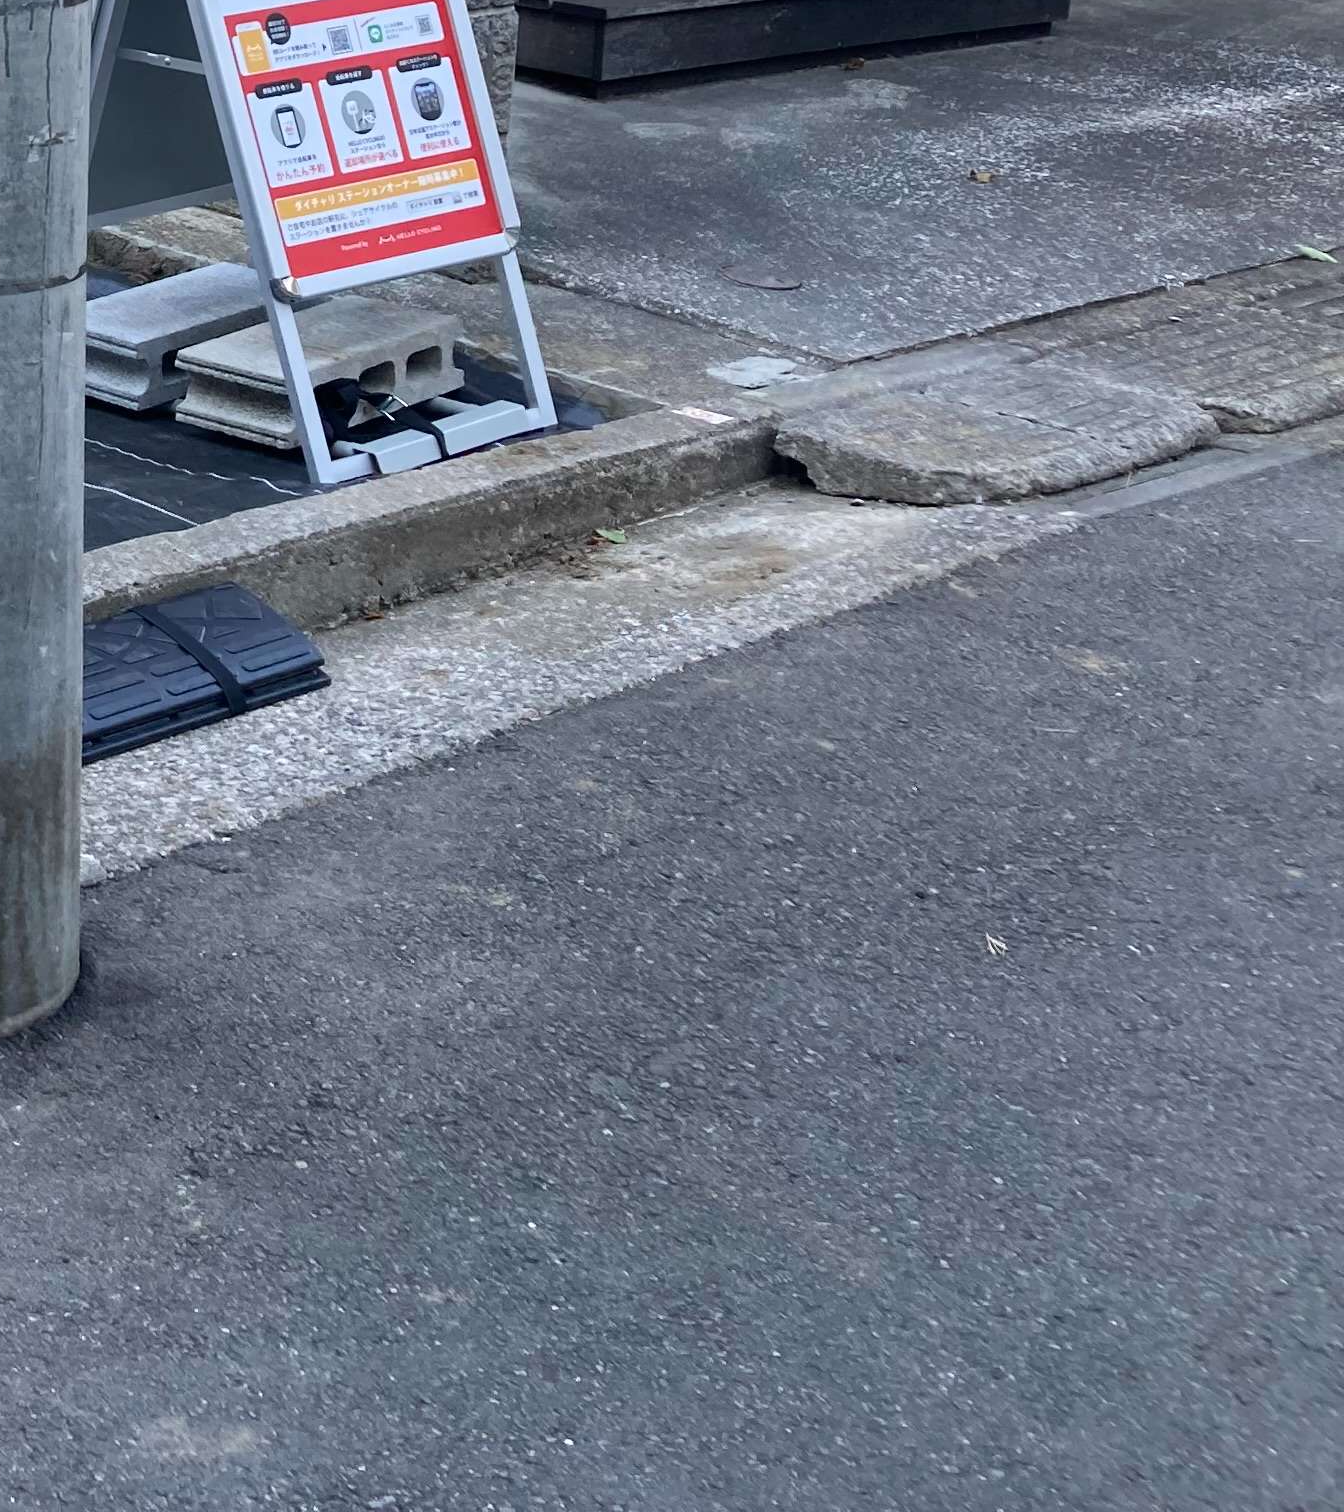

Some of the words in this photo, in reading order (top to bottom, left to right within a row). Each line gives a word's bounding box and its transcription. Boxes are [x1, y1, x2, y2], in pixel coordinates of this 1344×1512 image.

[276, 164, 326, 181] かんたん予約
[294, 194, 335, 212] ダイチャリ
